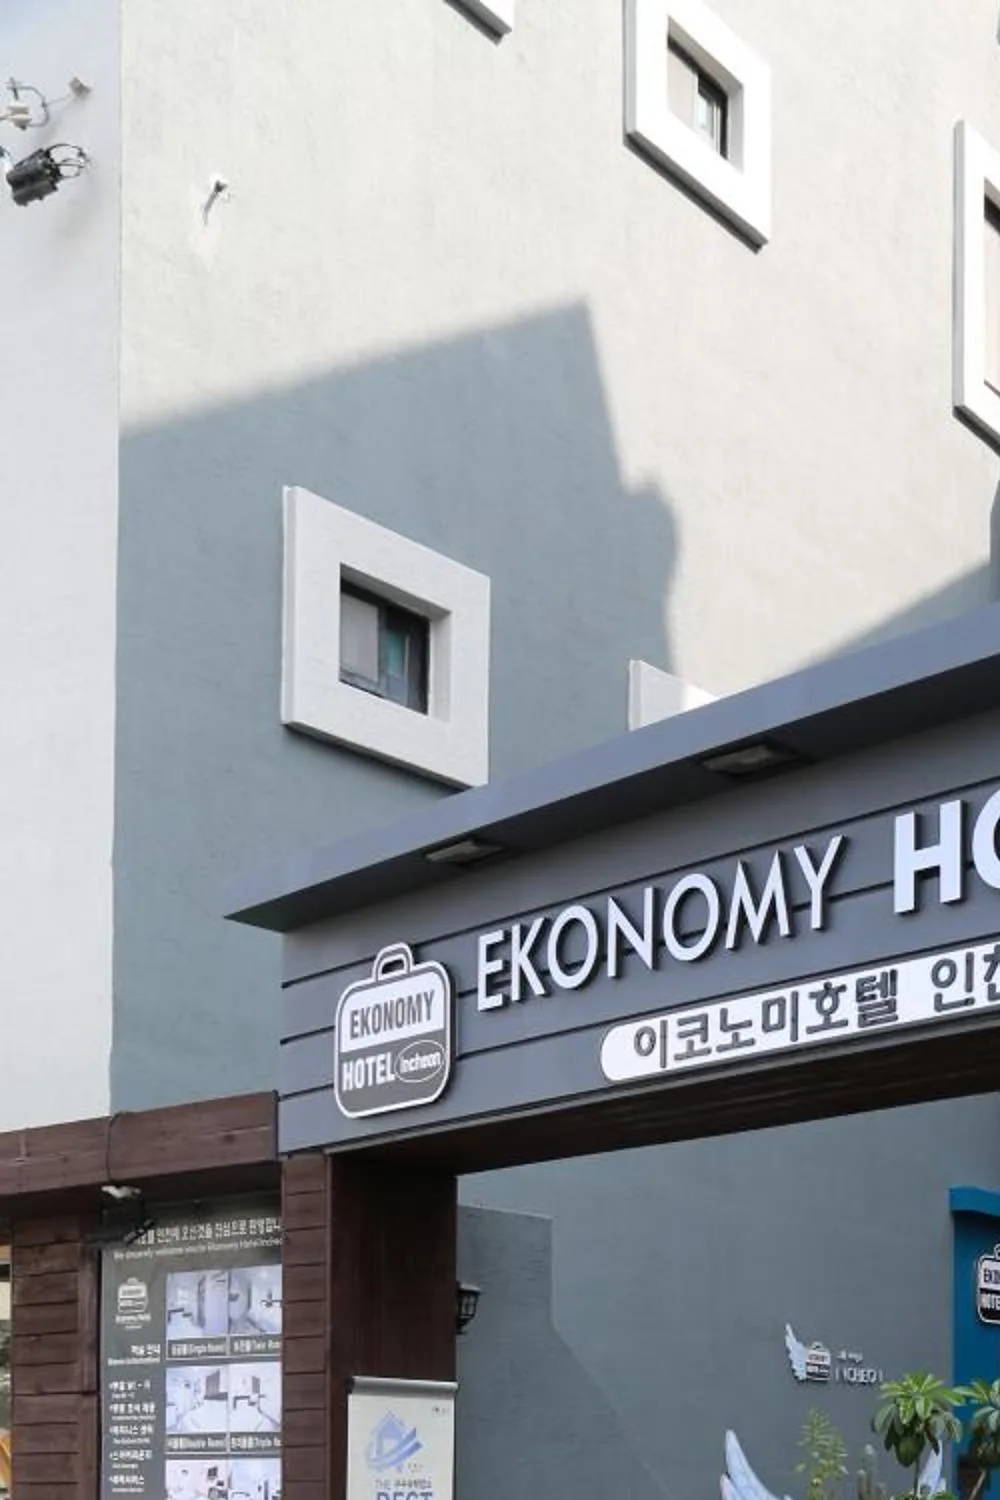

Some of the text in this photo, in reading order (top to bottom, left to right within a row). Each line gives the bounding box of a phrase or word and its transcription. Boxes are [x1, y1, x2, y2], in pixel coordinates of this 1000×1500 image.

[477, 835, 848, 1012] EKONOMY
[350, 989, 436, 1041] EKONOMY
[632, 973, 899, 1070] 이코노미호텔
[341, 1051, 396, 1092] HOTEL
